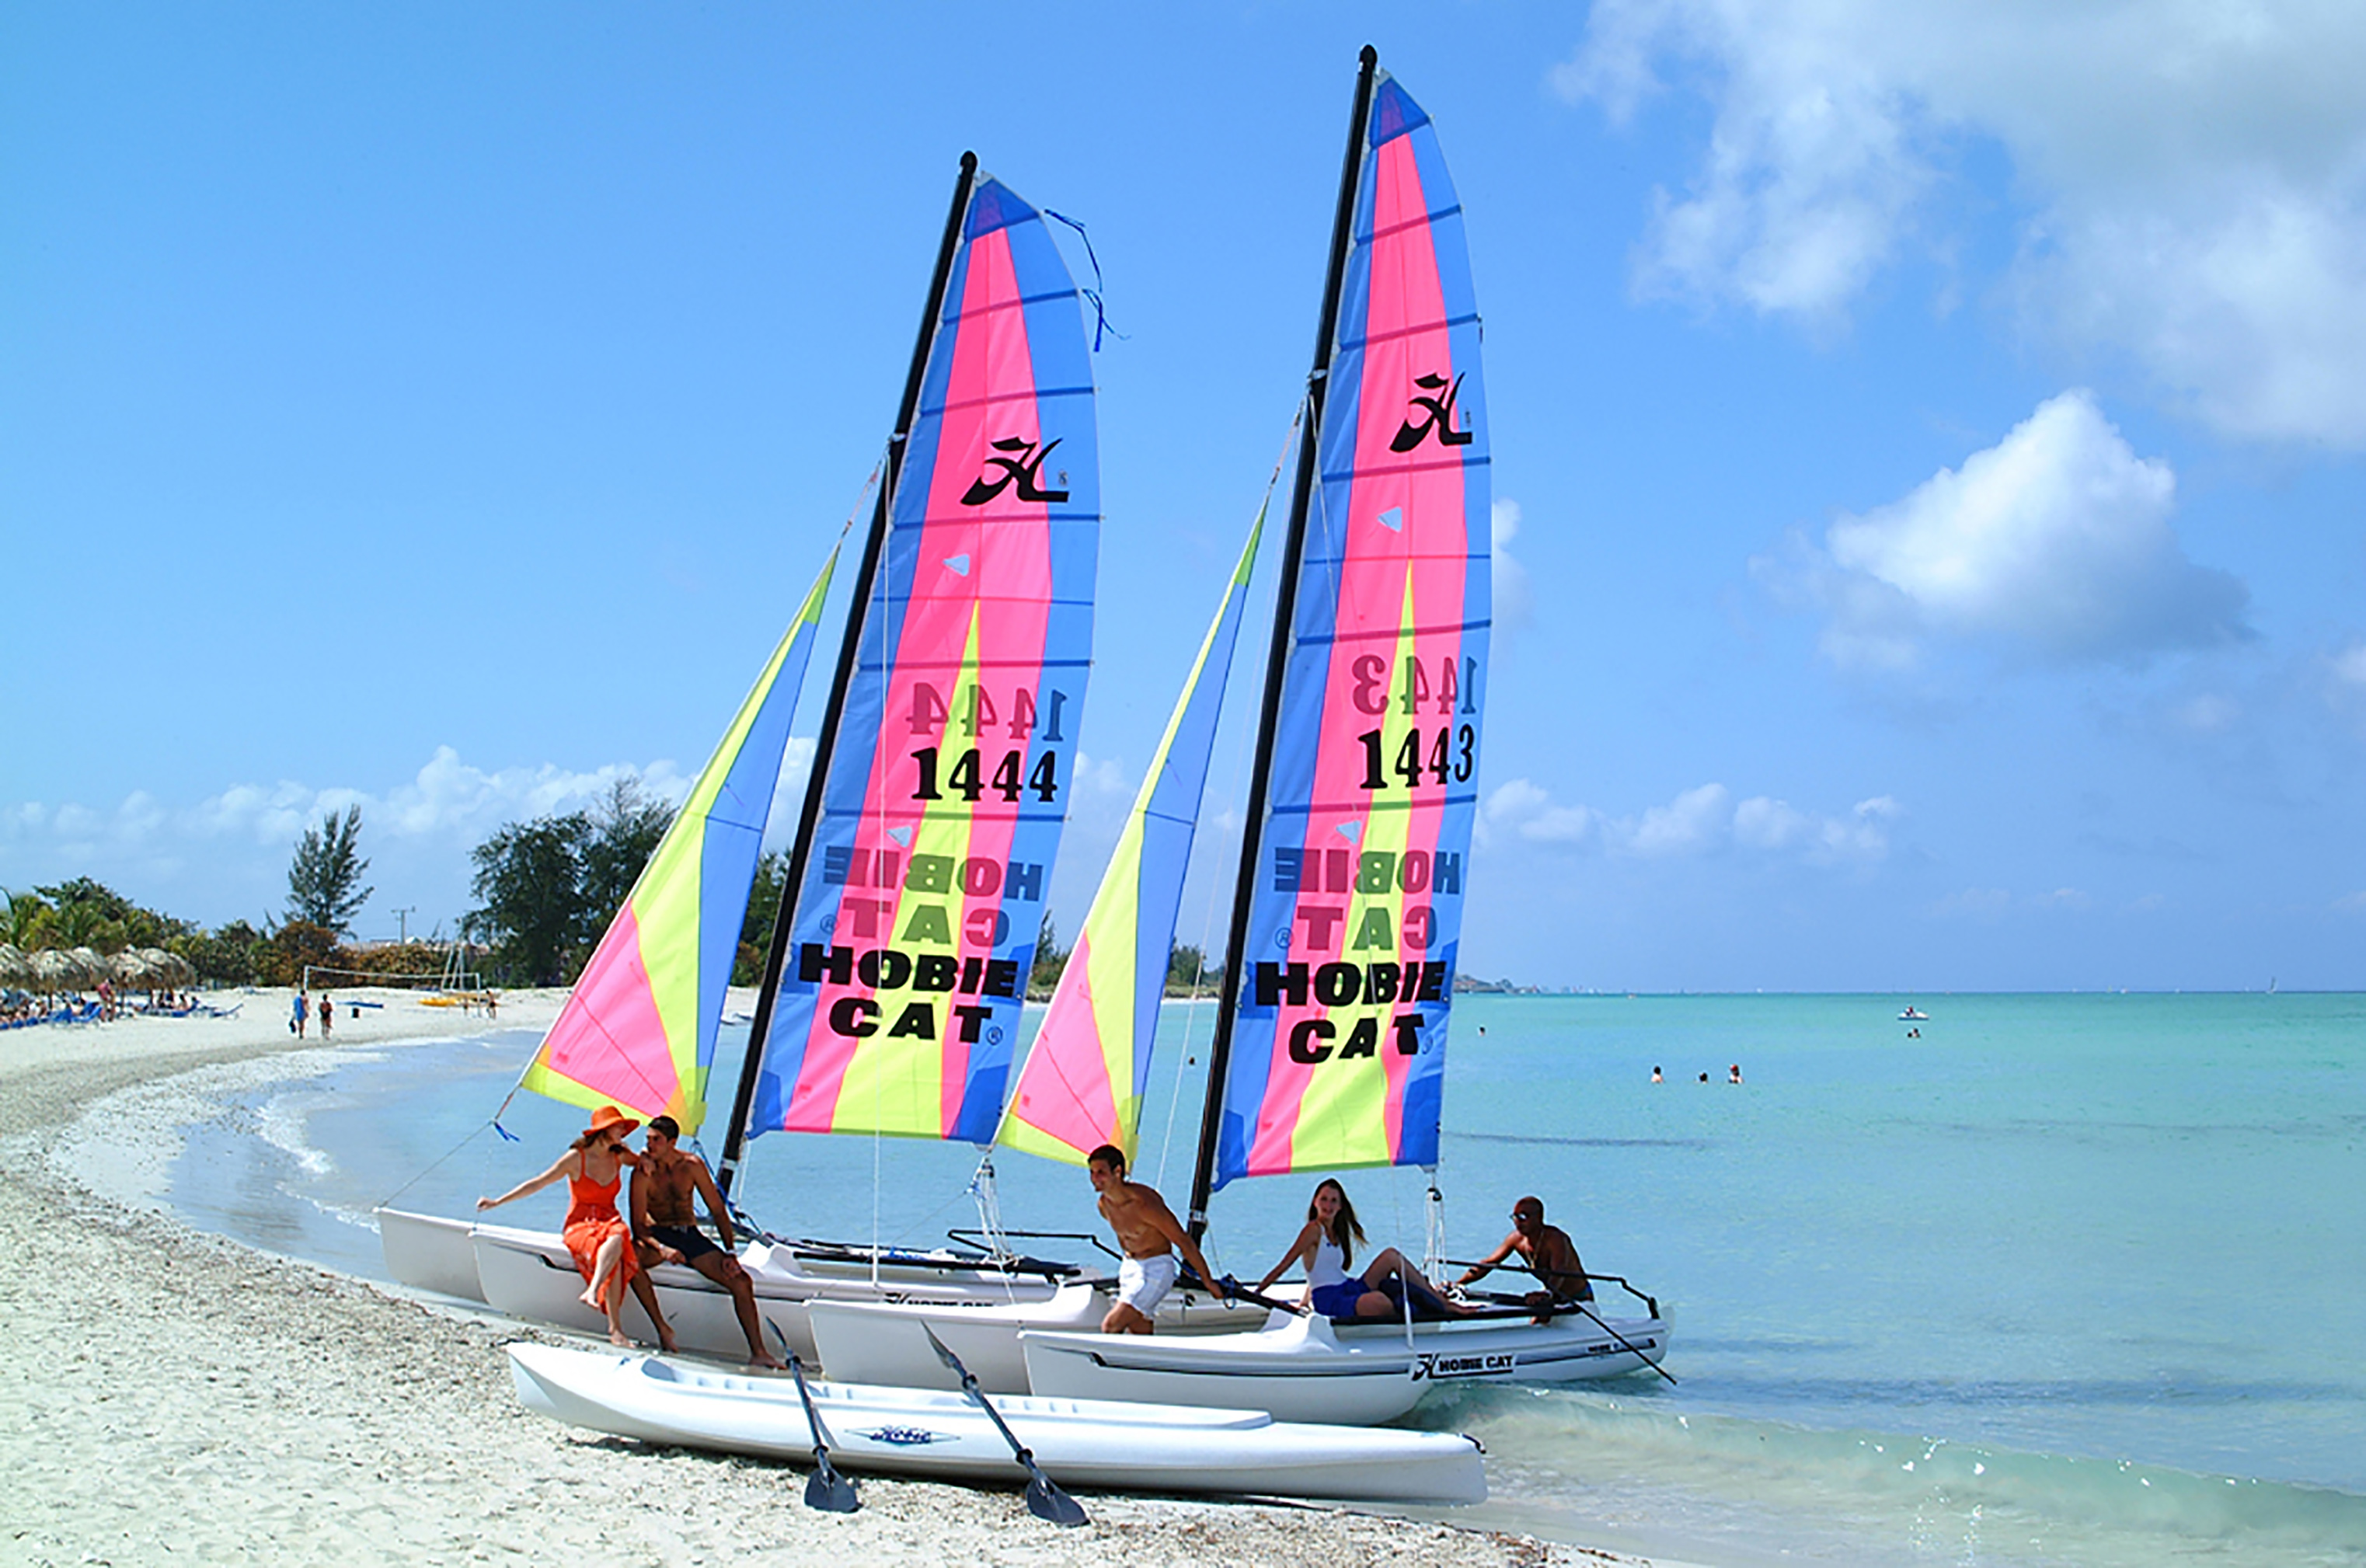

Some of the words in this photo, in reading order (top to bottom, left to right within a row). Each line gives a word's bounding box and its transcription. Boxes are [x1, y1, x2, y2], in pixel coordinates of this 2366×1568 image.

[911, 747, 1058, 803] 1444
[1357, 723, 1474, 789] 1443
[798, 943, 1019, 998] HOBIE
[1254, 960, 1447, 1007] HOBIE
[828, 997, 993, 1044] CAT
[1288, 1013, 1425, 1064] CAT
[1486, 1354, 1514, 1369] CAT
